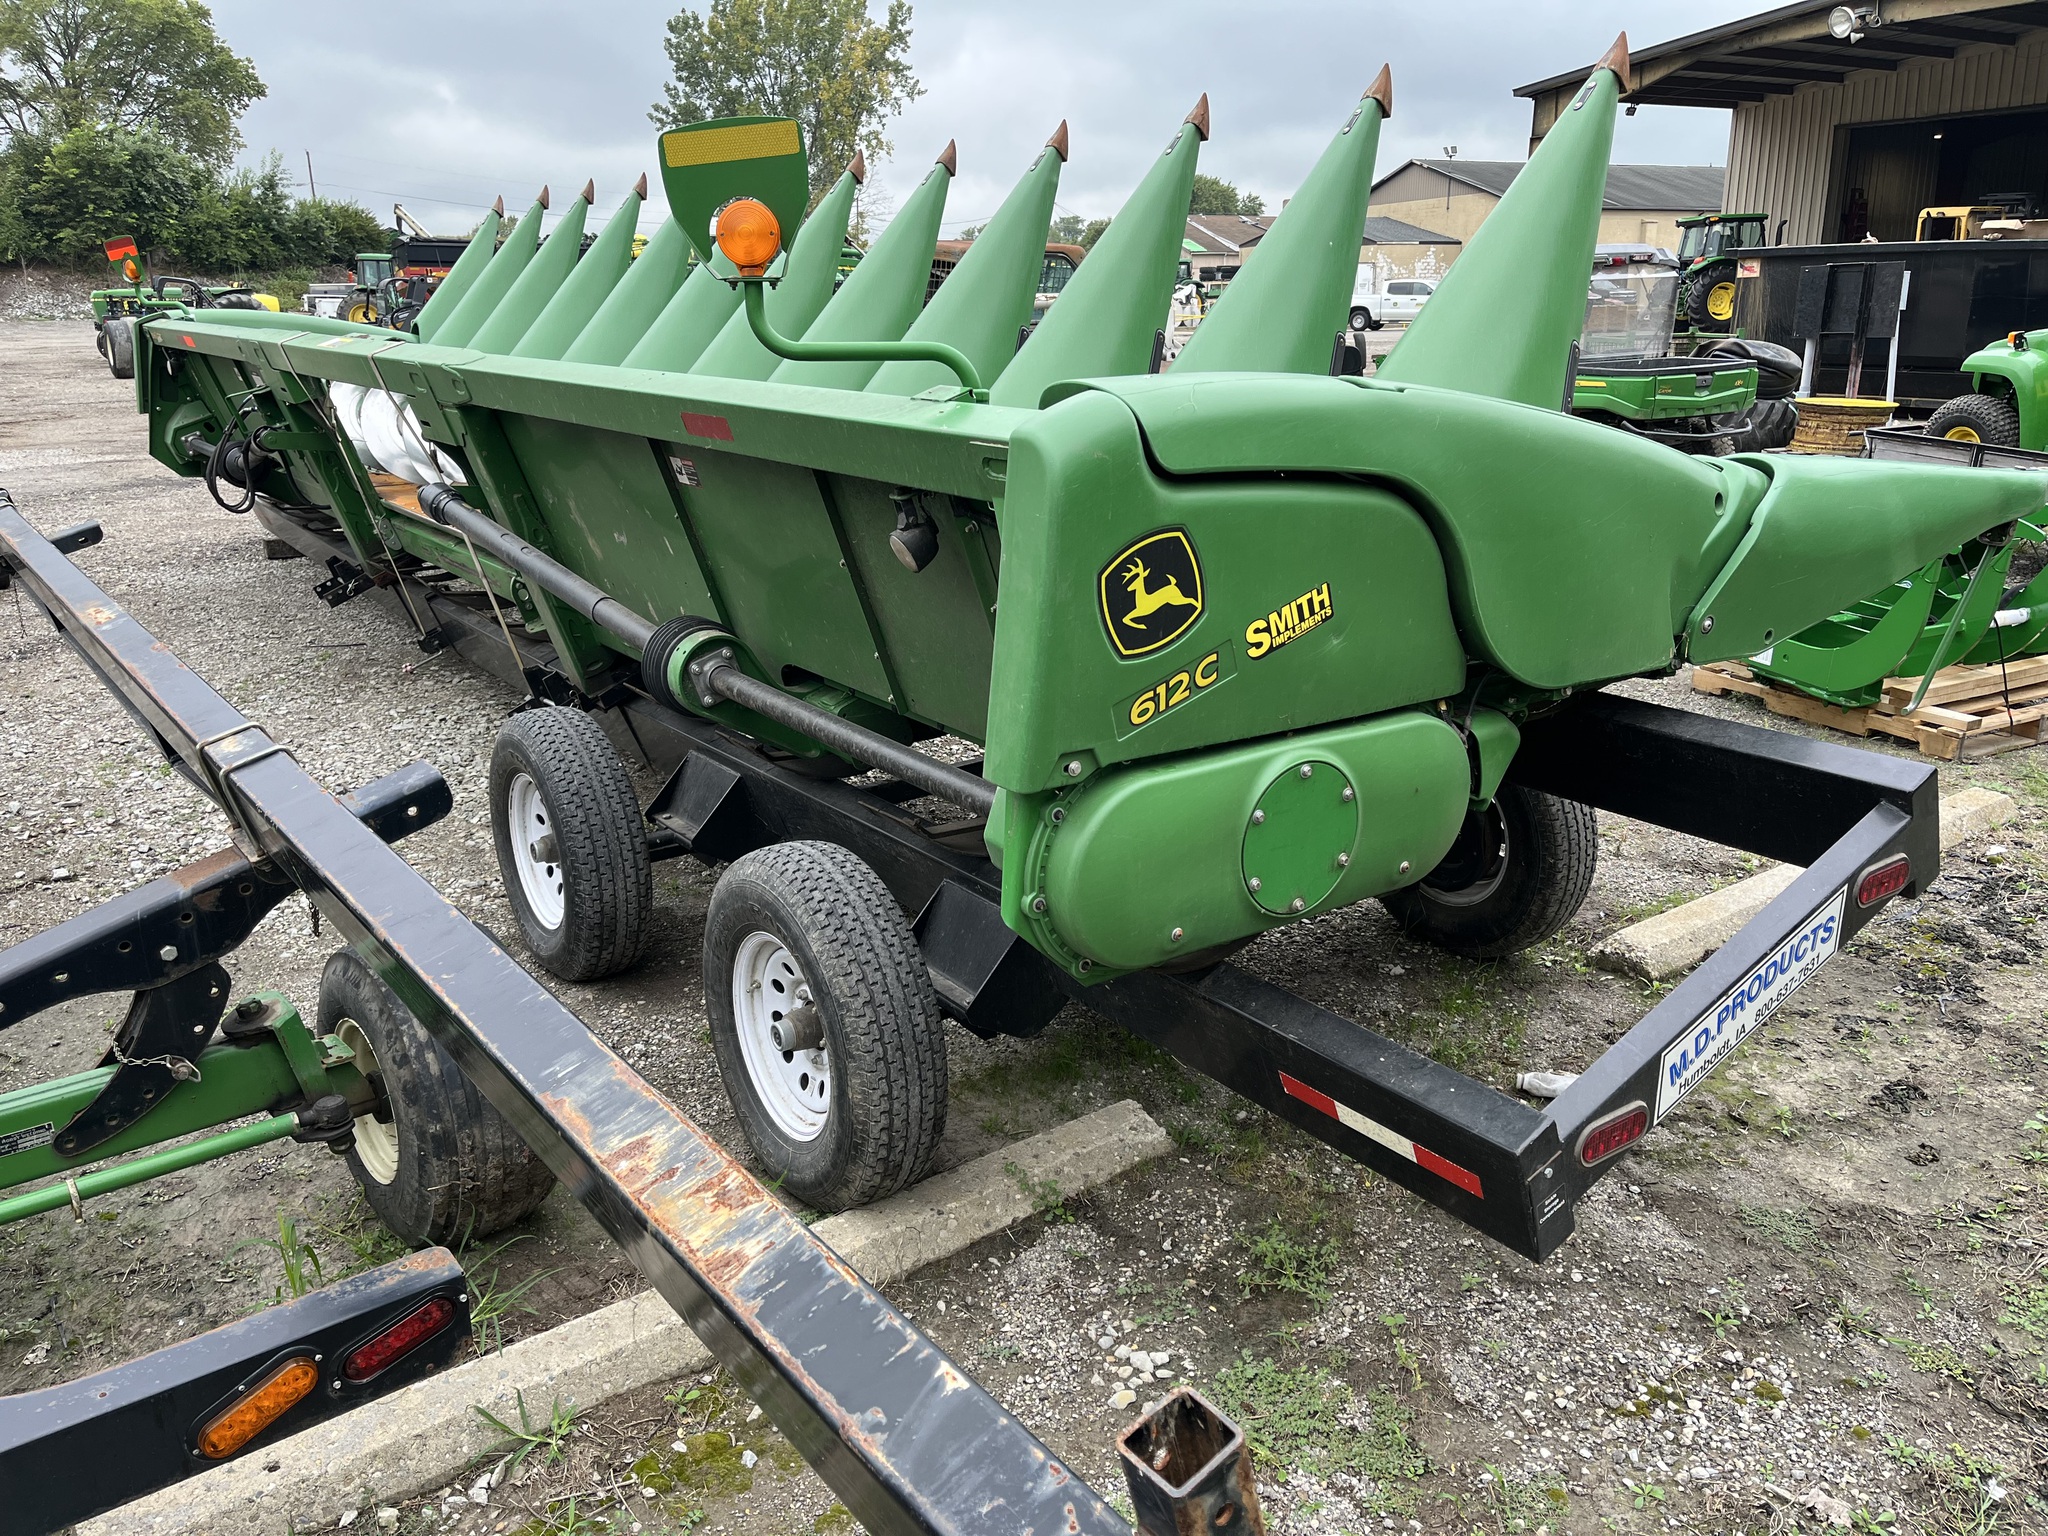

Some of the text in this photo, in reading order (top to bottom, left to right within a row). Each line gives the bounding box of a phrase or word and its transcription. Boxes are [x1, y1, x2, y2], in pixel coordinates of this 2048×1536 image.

[1245, 582, 1331, 659] SMITH
[1272, 606, 1333, 648] IMPLEMENTS
[1735, 1023, 1746, 1042] IA
[1754, 952, 1820, 1023] 800-637-7631
